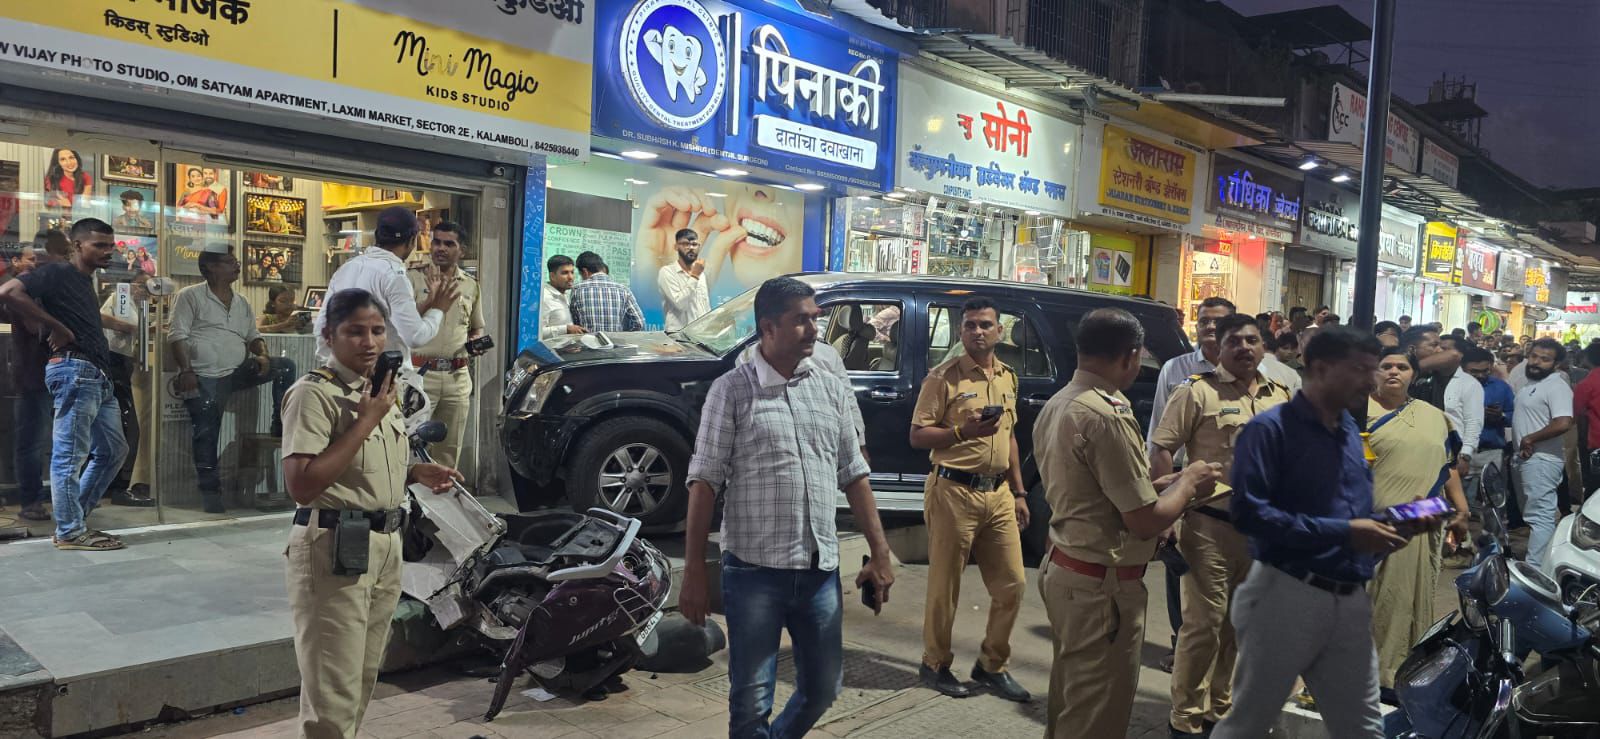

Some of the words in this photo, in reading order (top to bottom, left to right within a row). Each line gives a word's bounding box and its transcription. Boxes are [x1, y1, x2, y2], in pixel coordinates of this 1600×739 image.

[13, 44, 57, 64] VIJAY
[60, 53, 113, 73] PHOTO
[176, 74, 198, 89] OM
[201, 79, 253, 98] SATYAM
[255, 89, 331, 113] APARTMENT,
[332, 103, 367, 119] LAXMI
[369, 110, 414, 129] MARKET,
[416, 119, 456, 135] SECTOR
[394, 30, 459, 77] Mini
[463, 48, 540, 102] Magic
[752, 24, 885, 130] पिनाकी
[426, 85, 458, 100] KIDS
[462, 94, 510, 112] STUDIO
[622, 129, 636, 139] DR.
[637, 132, 673, 146] SUBHASH
[776, 127, 817, 153] दातांचा
[820, 138, 865, 163] दवाखाना
[981, 101, 1032, 158] सोनी
